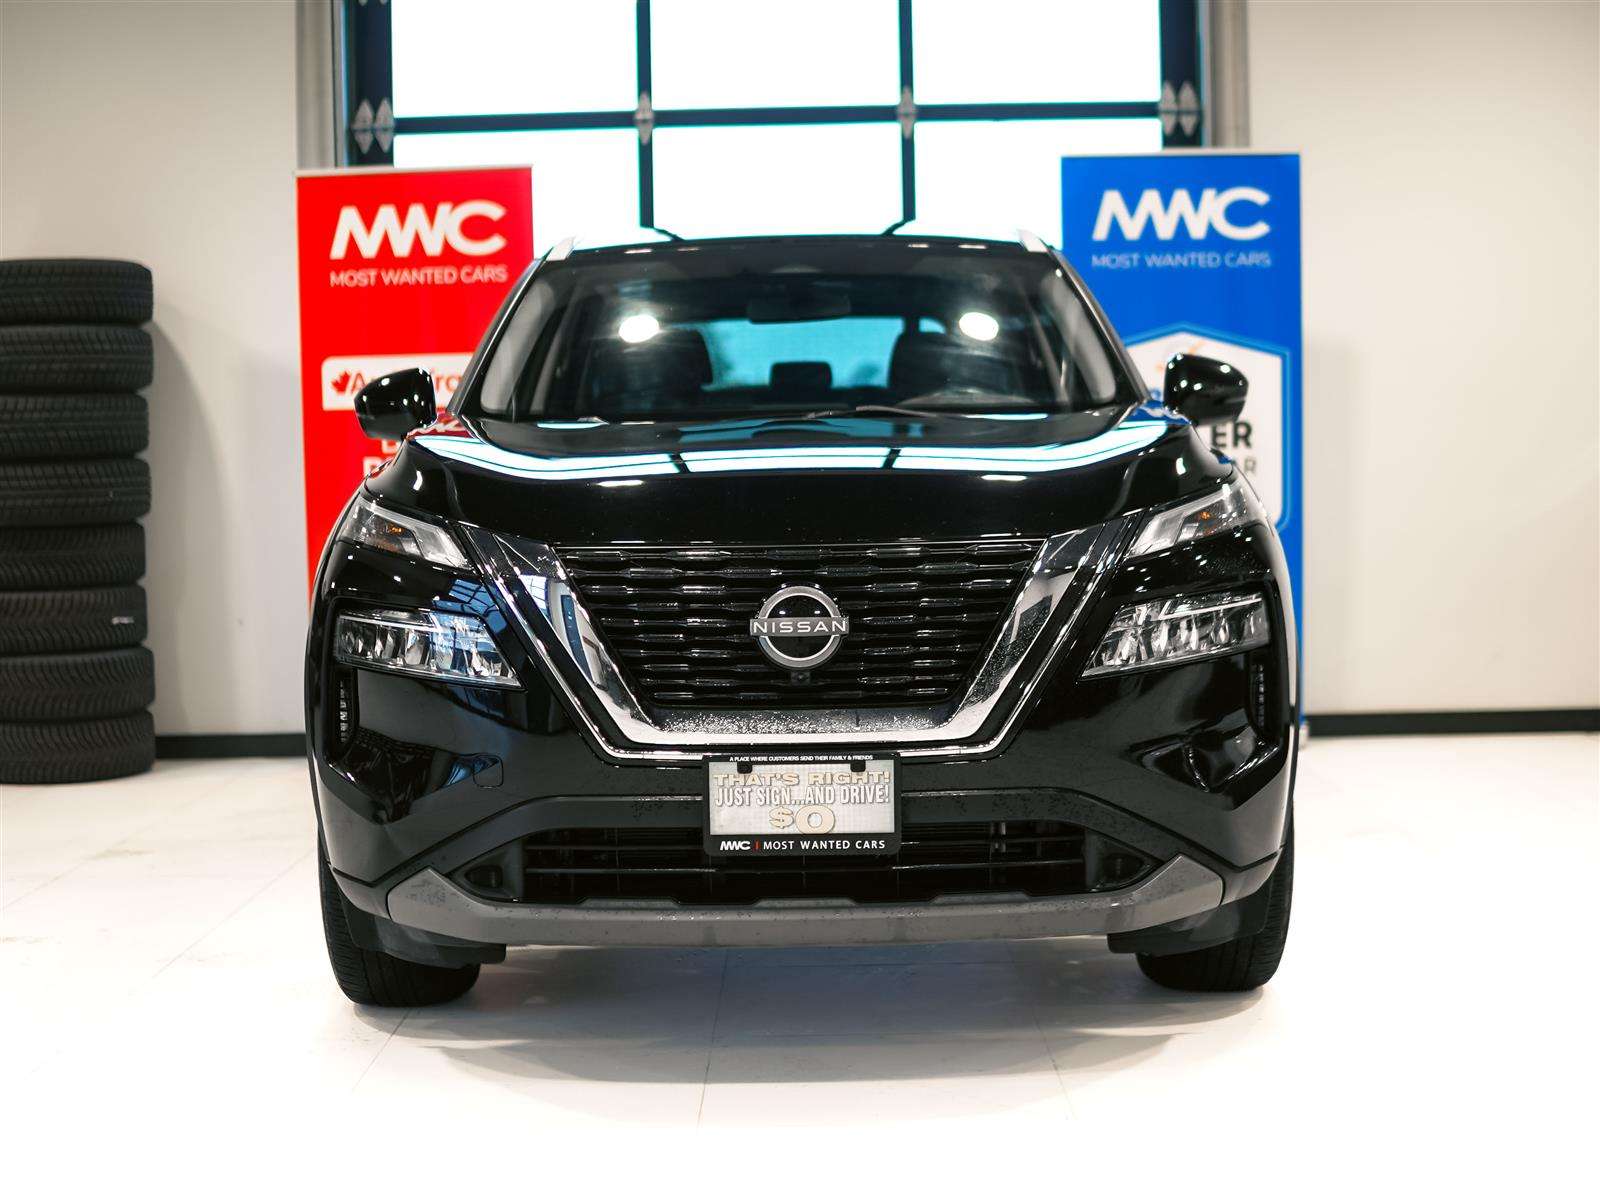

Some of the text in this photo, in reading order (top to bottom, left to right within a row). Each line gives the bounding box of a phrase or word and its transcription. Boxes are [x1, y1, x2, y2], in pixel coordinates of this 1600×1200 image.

[1092, 187, 1270, 241] MWC
[329, 199, 507, 260] MWC
[1092, 251, 1271, 269] MOST WANTED CARS
[329, 264, 508, 287] MOST WANTED CARS
[753, 620, 846, 633] NISSAN
[713, 771, 890, 786] THAT'S RIGHT!
[716, 786, 752, 806] JUST
[840, 784, 890, 804] DRIVE!
[720, 840, 885, 851] MWC MOST WANTED CARS
